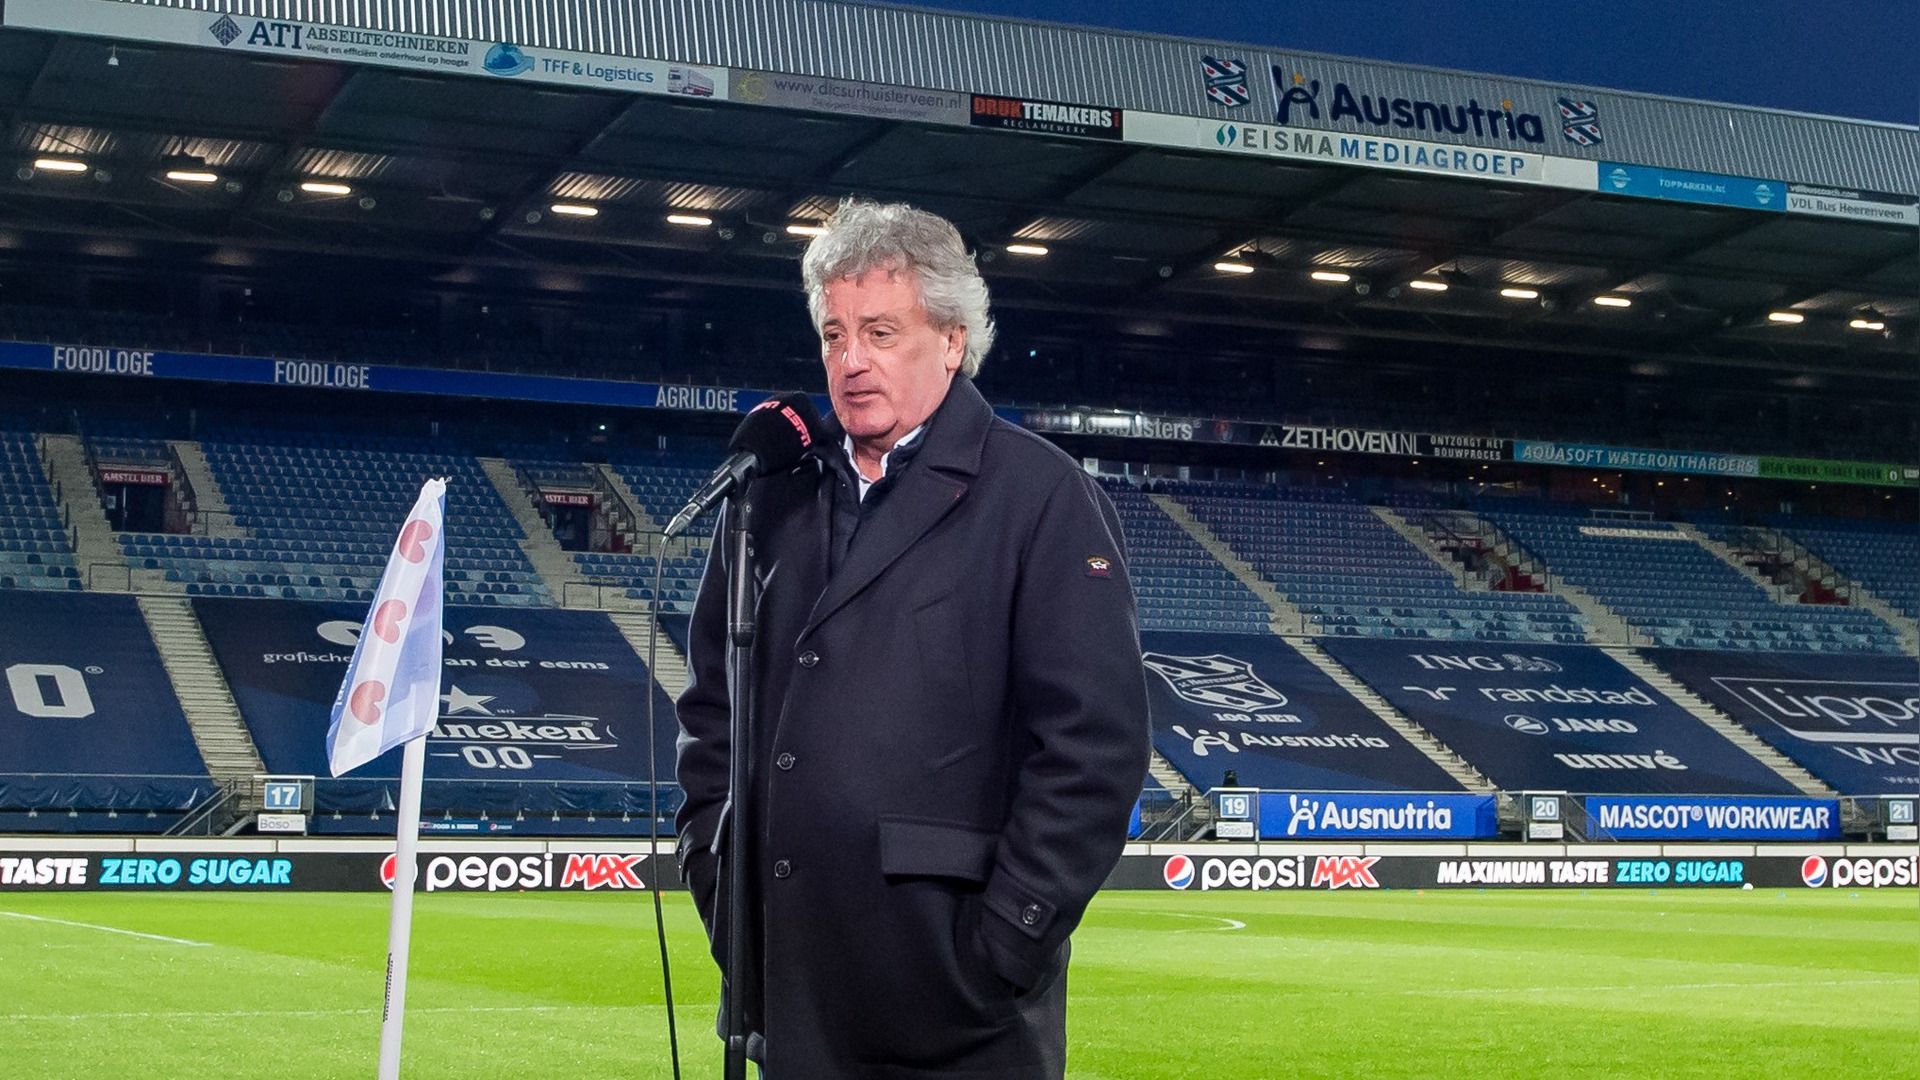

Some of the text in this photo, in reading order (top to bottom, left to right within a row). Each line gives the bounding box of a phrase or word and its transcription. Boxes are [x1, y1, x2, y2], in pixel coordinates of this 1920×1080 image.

[247, 21, 303, 49] ATI
[306, 27, 469, 55] ABSEILTECHNIEKEN
[306, 43, 329, 54] Veilig
[380, 50, 426, 63] onderhoud
[427, 56, 439, 65] op
[440, 56, 469, 67] hoogte
[542, 58, 654, 85] TFF & Logistics
[1332, 83, 1546, 144] Ausnutria
[1003, 119, 1086, 134] RECLAMEWERK
[1243, 128, 1526, 176] EISMA MEDIAGROEP
[1791, 197, 1904, 219] VDL Bus Heerenveen
[54, 346, 154, 376] FOODLOGE
[274, 360, 370, 388] FOODLOGE
[656, 386, 738, 411] AGRILOGE
[781, 405, 812, 447] ESPN
[1281, 426, 1422, 456] ZETHOVEN.NL
[1430, 435, 1481, 447] ONTZORGT
[1434, 447, 1501, 461] BOUWPROCES
[1522, 445, 1603, 463] AQUASOFT
[1608, 451, 1755, 474] WATERONTHARDERS
[443, 658, 478, 667] an
[485, 658, 531, 668] der
[539, 661, 610, 670] eems
[1408, 654, 1505, 672] ING
[1478, 684, 1657, 706] randstad
[431, 721, 601, 741] ineken
[1551, 717, 1638, 734] JAKO
[1240, 731, 1390, 749] Ausnutria
[462, 746, 533, 770] 0.0
[271, 786, 297, 805] 17
[1225, 798, 1246, 815] 19
[1320, 801, 1451, 830] Ausnutria
[1535, 800, 1556, 817] 20
[1705, 806, 1830, 830] WORKWEAR
[1892, 804, 1910, 820] 21
[0, 858, 293, 885] TASTE ZERO SUGAR
[426, 853, 649, 891] pepsi MAX
[1202, 856, 1382, 891] pepsi MAX
[1437, 861, 1745, 884] MAXIMUM TASTE ZERO SUGAR
[1832, 855, 1918, 889] pepsi
